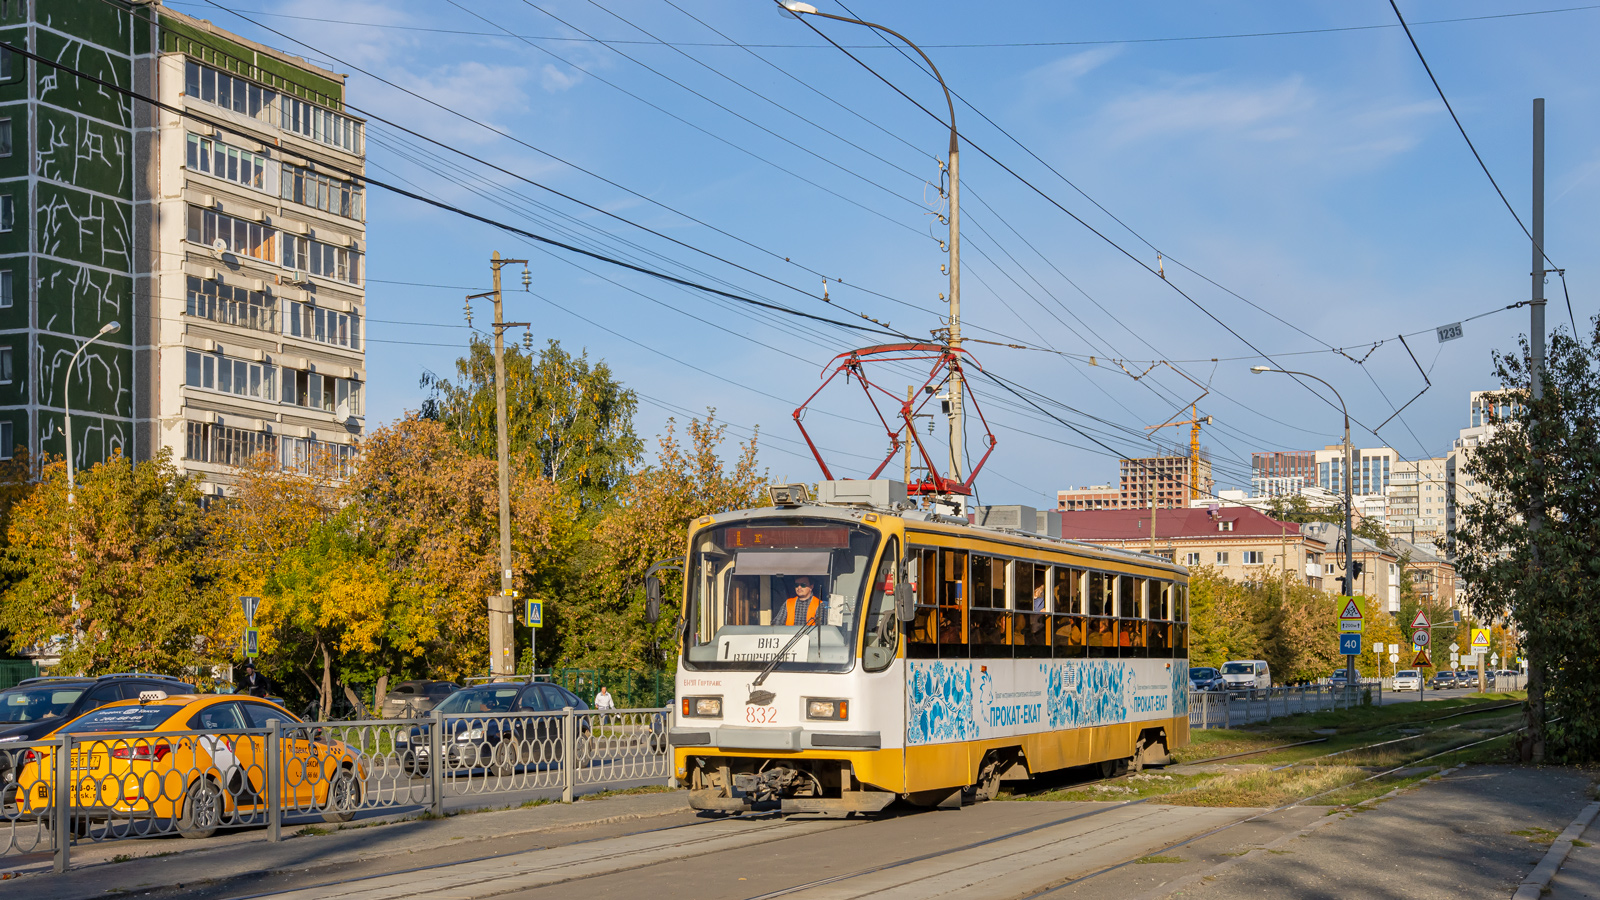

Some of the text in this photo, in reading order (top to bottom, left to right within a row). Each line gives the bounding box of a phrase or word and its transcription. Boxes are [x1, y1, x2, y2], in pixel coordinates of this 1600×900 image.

[1439, 326, 1462, 341] 1235
[724, 641, 730, 659] 1
[1344, 640, 1357, 649] 40
[1133, 695, 1168, 713] ПРОКАТ-ЕКАТ
[746, 707, 777, 723] 832
[990, 703, 1042, 728] ПРОКАТ-ЕКАТ
